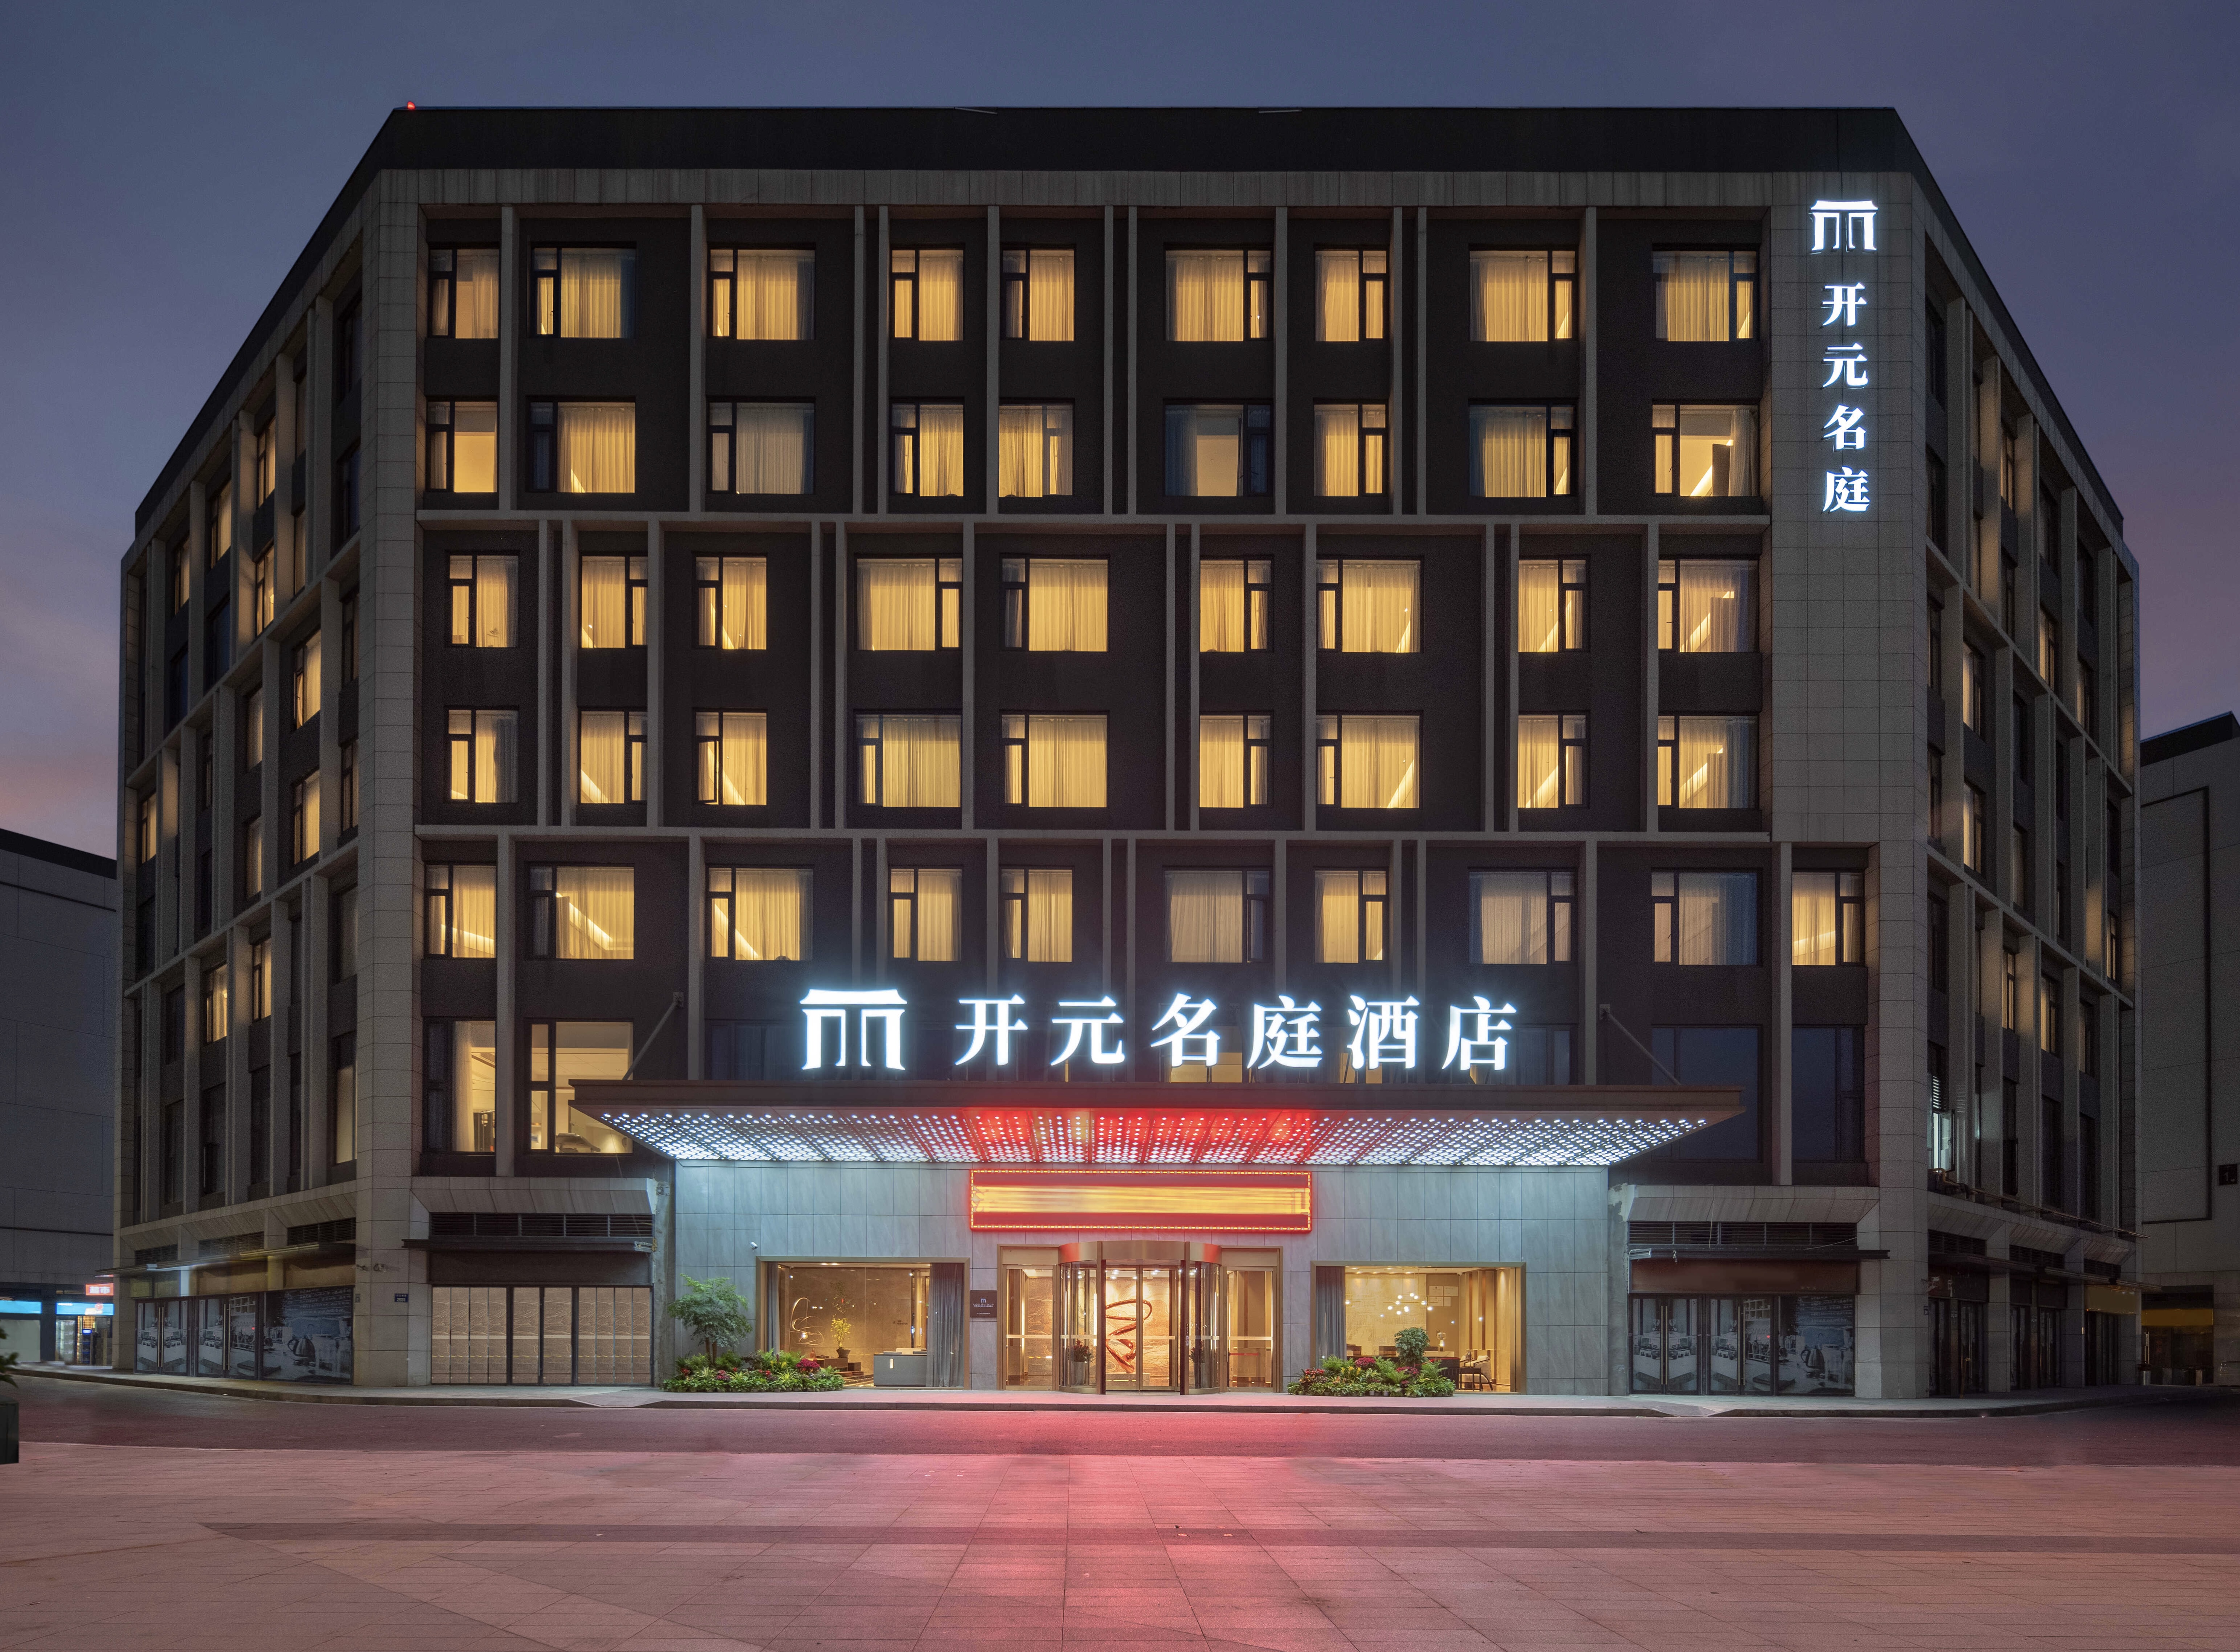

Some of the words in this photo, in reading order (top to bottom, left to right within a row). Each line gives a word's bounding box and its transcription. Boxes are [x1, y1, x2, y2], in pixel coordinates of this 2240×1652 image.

[1822, 282, 1870, 512] 开元名庭
[954, 992, 1518, 1071] 开元名庭酒店
